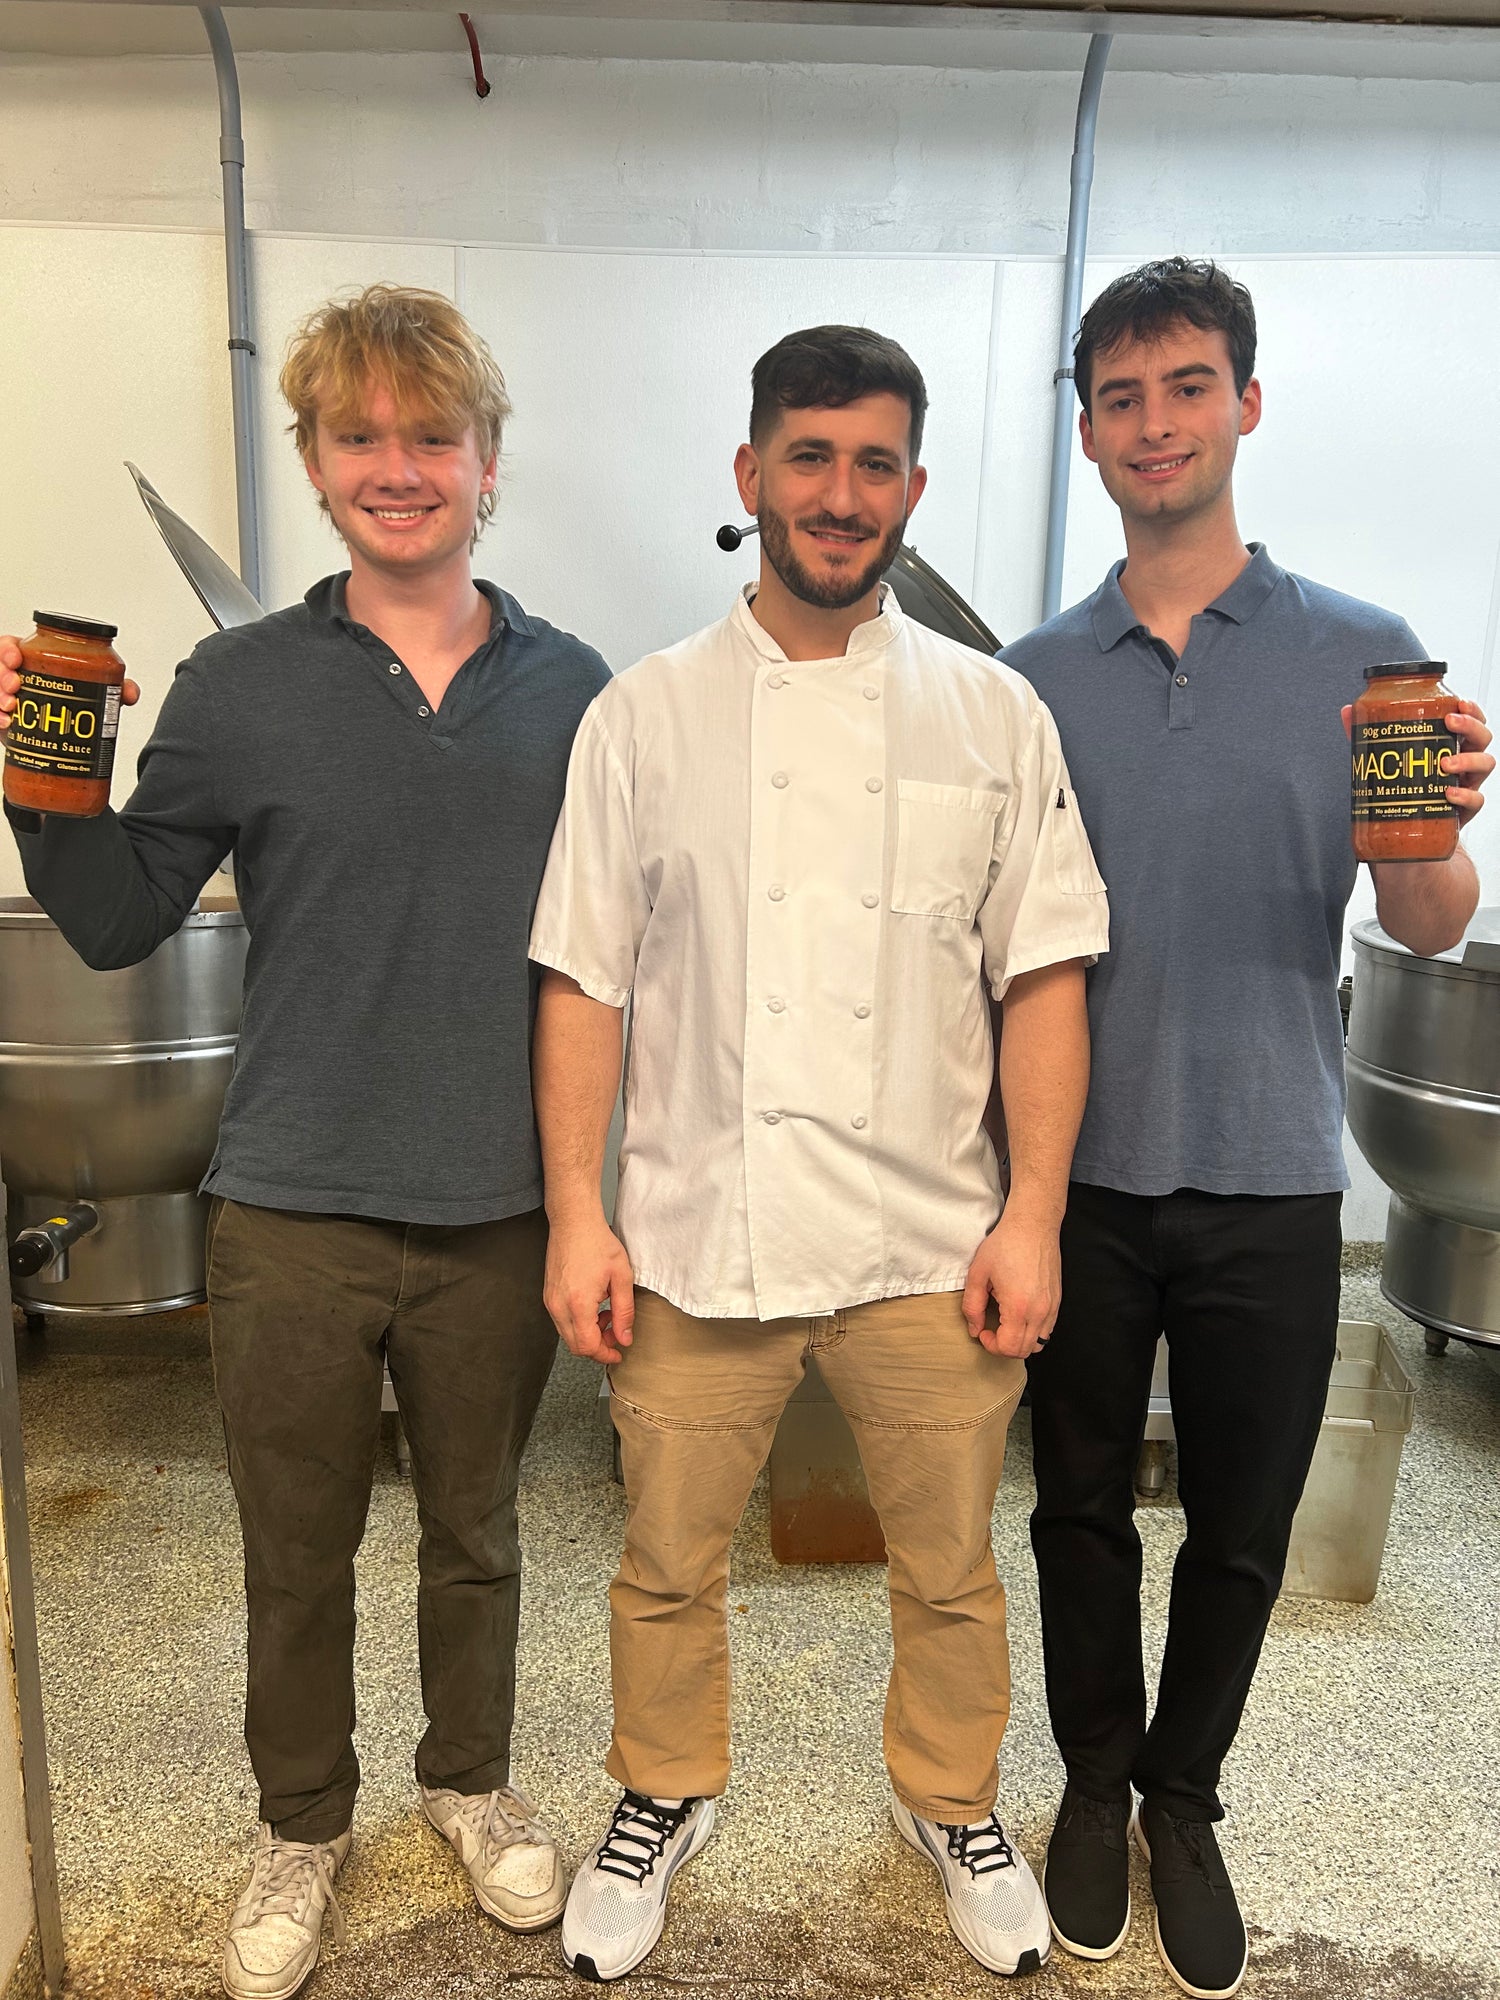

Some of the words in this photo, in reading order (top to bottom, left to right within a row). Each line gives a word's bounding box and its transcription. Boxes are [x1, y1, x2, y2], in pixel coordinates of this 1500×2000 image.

[25, 674, 36, 685] of
[35, 676, 74, 693] Protein
[11, 697, 96, 739] ACHO
[1362, 727, 1380, 739] 90g
[1380, 724, 1394, 735] of
[1394, 722, 1434, 734] Protein
[16, 732, 58, 750] Marinara
[62, 742, 91, 754] Sauce
[57, 763, 91, 772] Gluten-free
[1376, 785, 1424, 796] Marinara
[1402, 807, 1418, 815] sugar
